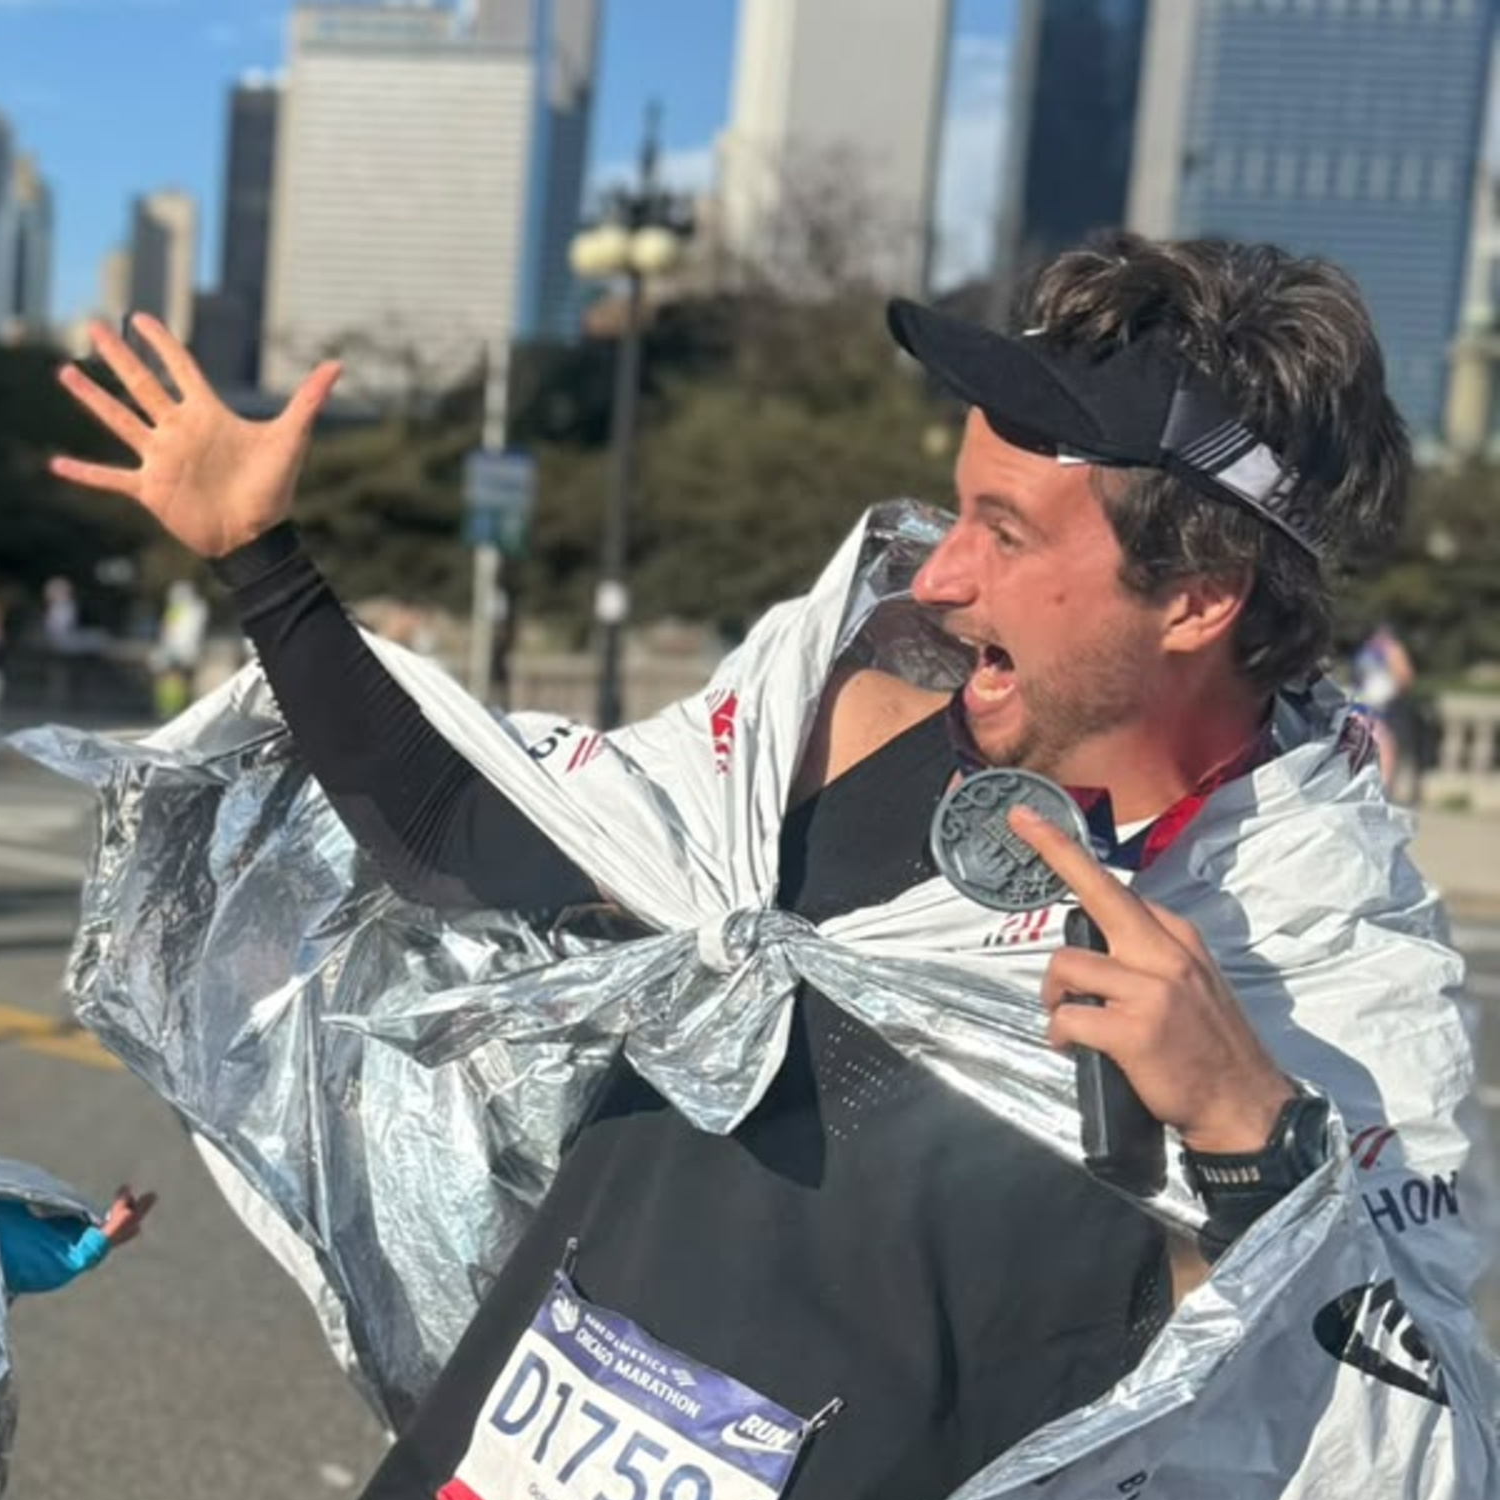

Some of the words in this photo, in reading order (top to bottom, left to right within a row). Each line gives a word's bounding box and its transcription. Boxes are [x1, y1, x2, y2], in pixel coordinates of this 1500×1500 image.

[574, 1327, 615, 1367] CHICAGO
[613, 1358, 702, 1420] MARATHON
[612, 1337, 669, 1377] AMERICA
[737, 1412, 797, 1451] RUN
